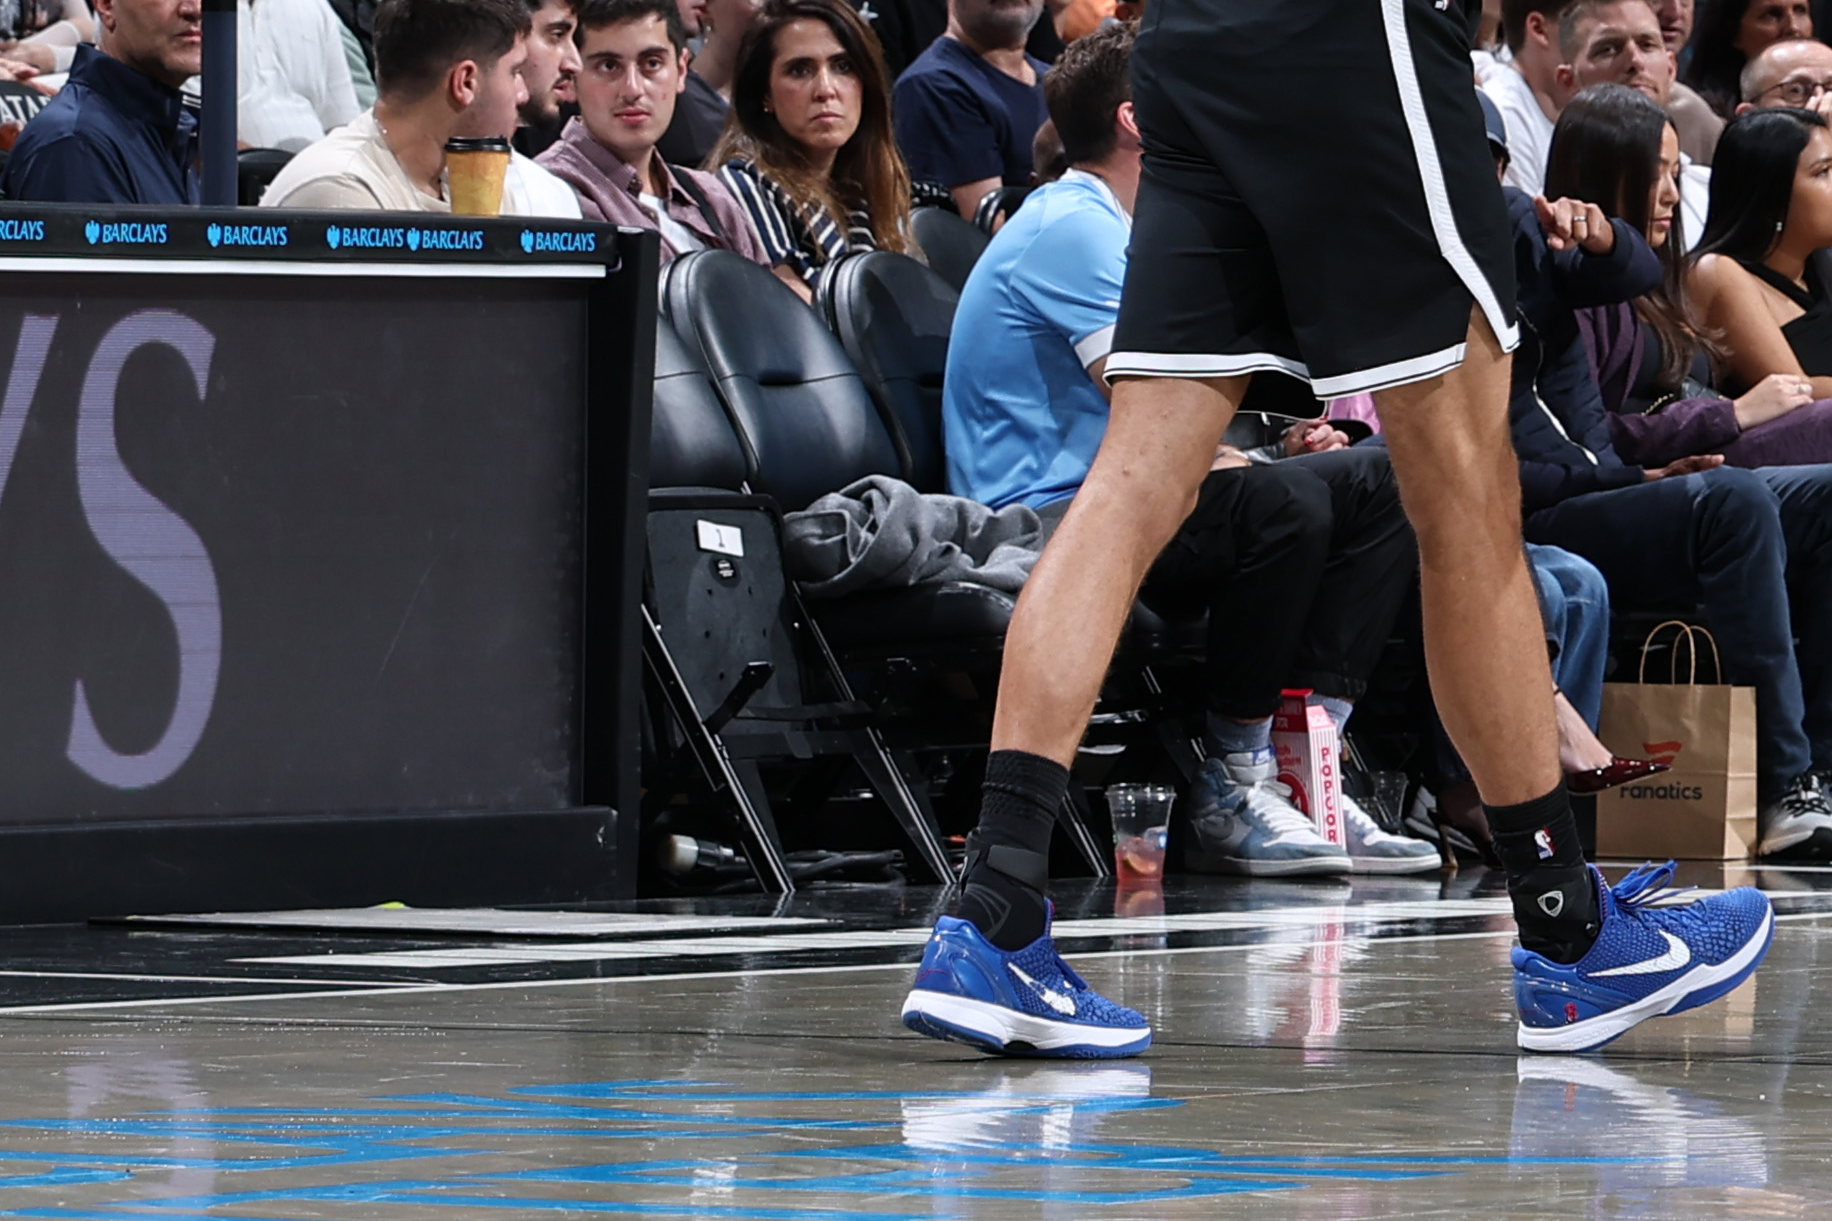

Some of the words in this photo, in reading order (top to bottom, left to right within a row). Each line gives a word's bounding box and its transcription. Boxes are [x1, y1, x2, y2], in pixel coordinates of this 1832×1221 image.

[102, 222, 168, 245] BARCLAYS
[222, 225, 288, 246] BARCLAYS
[341, 227, 404, 248] BARCLAYS
[421, 229, 484, 251] BARCLAYS
[535, 231, 596, 252] BARCLAYS
